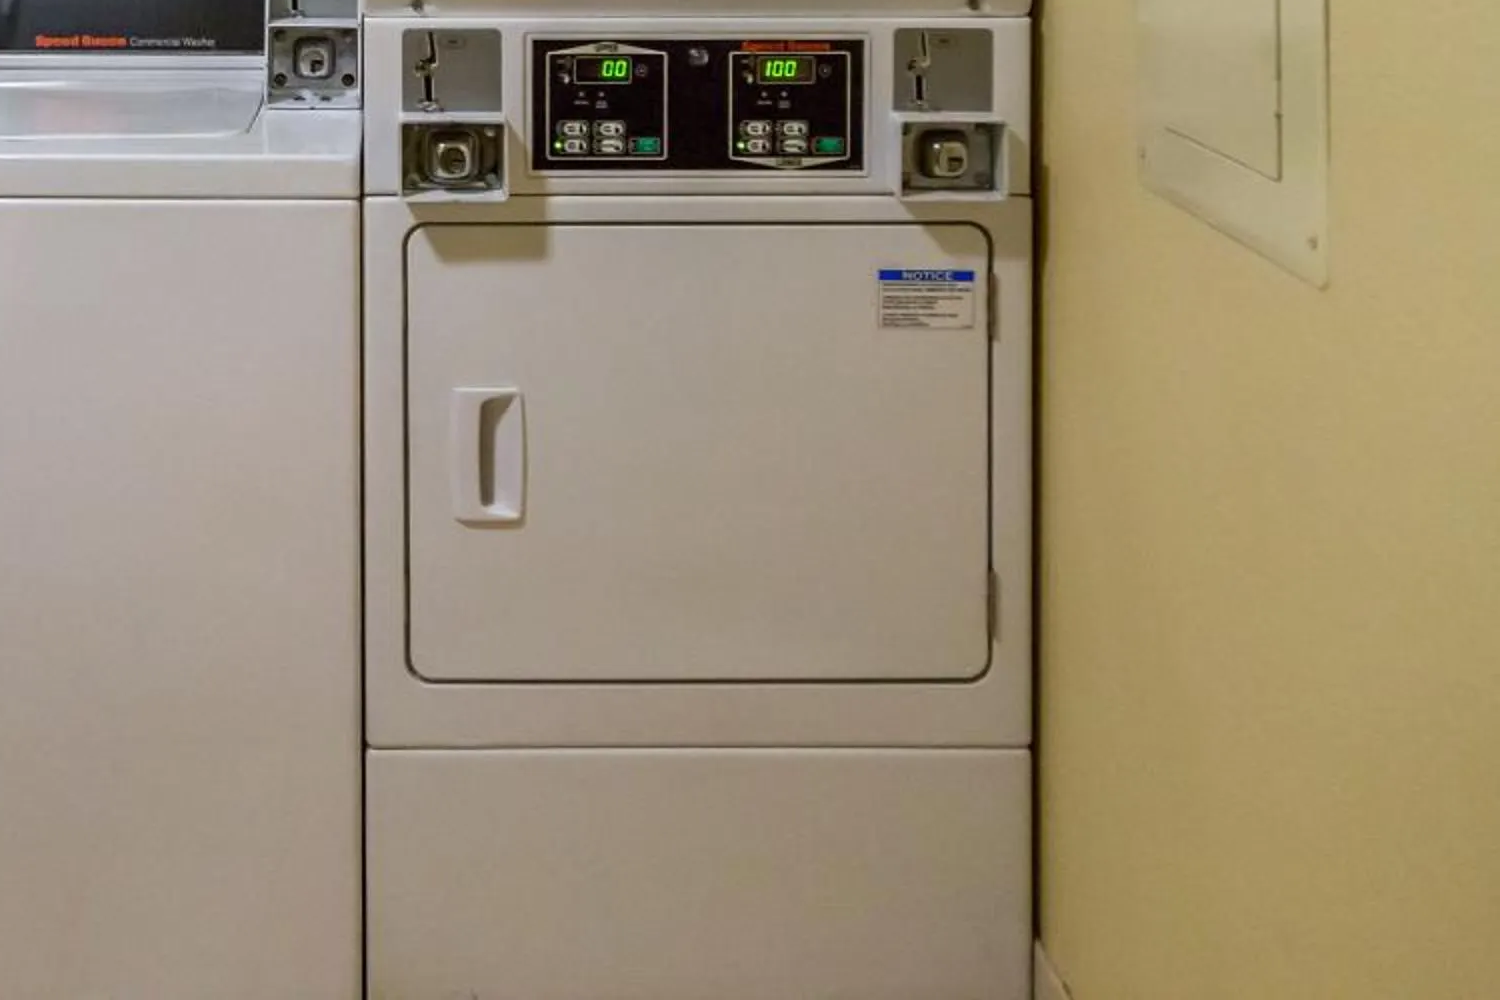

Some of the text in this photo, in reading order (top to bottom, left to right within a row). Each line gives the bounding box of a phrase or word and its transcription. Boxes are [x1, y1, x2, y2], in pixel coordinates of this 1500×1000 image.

[601, 59, 627, 78] 00
[764, 59, 798, 78] 100
[901, 270, 954, 281] NOTICE
